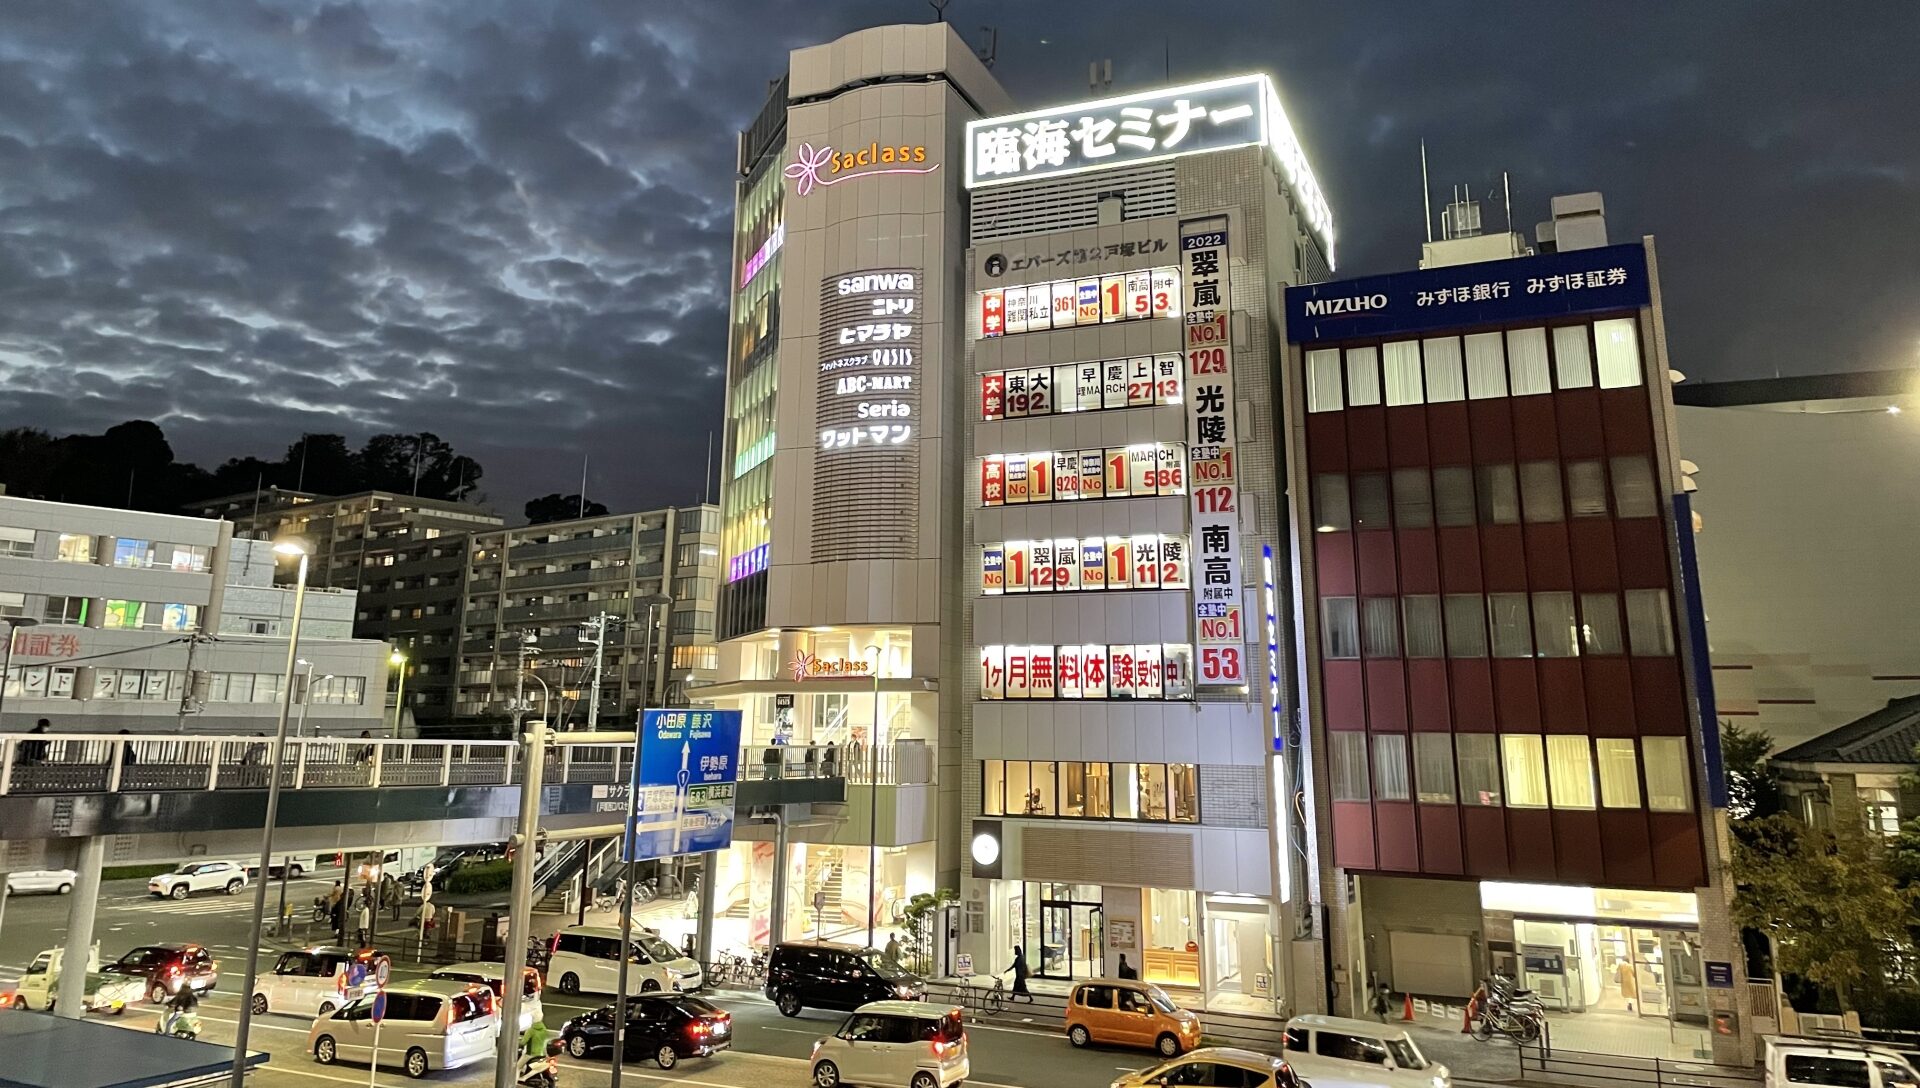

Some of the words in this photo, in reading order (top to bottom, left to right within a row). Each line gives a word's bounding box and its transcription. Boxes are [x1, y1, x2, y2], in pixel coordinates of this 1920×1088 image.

[976, 100, 1253, 176] 臨海セミナー
[831, 142, 926, 174] Saclass
[1188, 234, 1221, 249] 2022
[838, 273, 914, 295] sanwa
[1191, 250, 1221, 307] 翠嵐
[1417, 281, 1511, 306] みずほ銀行
[1527, 267, 1627, 294] みずほ証券
[872, 298, 914, 316] ニトリ
[985, 296, 1001, 331] 中学
[1054, 296, 1076, 315] 361
[1305, 294, 1388, 317] MIZUHO
[839, 323, 912, 345] ヒマラヤ
[1190, 315, 1227, 343] No.1
[821, 355, 868, 371] フィットネスクラブ
[872, 348, 913, 366] OASIS
[836, 375, 912, 394] ABC-MART
[1008, 373, 1048, 393] 東大
[985, 379, 1001, 412] 大学
[857, 399, 911, 418] Seria
[1196, 385, 1227, 445] 光陵
[822, 425, 911, 448] ワットマン
[1131, 449, 1174, 462] MARCH
[1195, 452, 1232, 480] No.1
[985, 464, 1001, 498] 高校
[1034, 547, 1076, 565] 翠嵐
[1137, 542, 1182, 562] 光陵
[1201, 524, 1232, 585] 南高
[1198, 603, 1227, 617] 全塾中
[1202, 609, 1240, 638] No.1
[813, 658, 868, 673] Saclass
[656, 713, 687, 729] 小田原
[691, 713, 712, 729] 藤沢
[700, 755, 728, 771] 伊勢原
[681, 773, 686, 784] 1
[690, 790, 706, 803] E83
